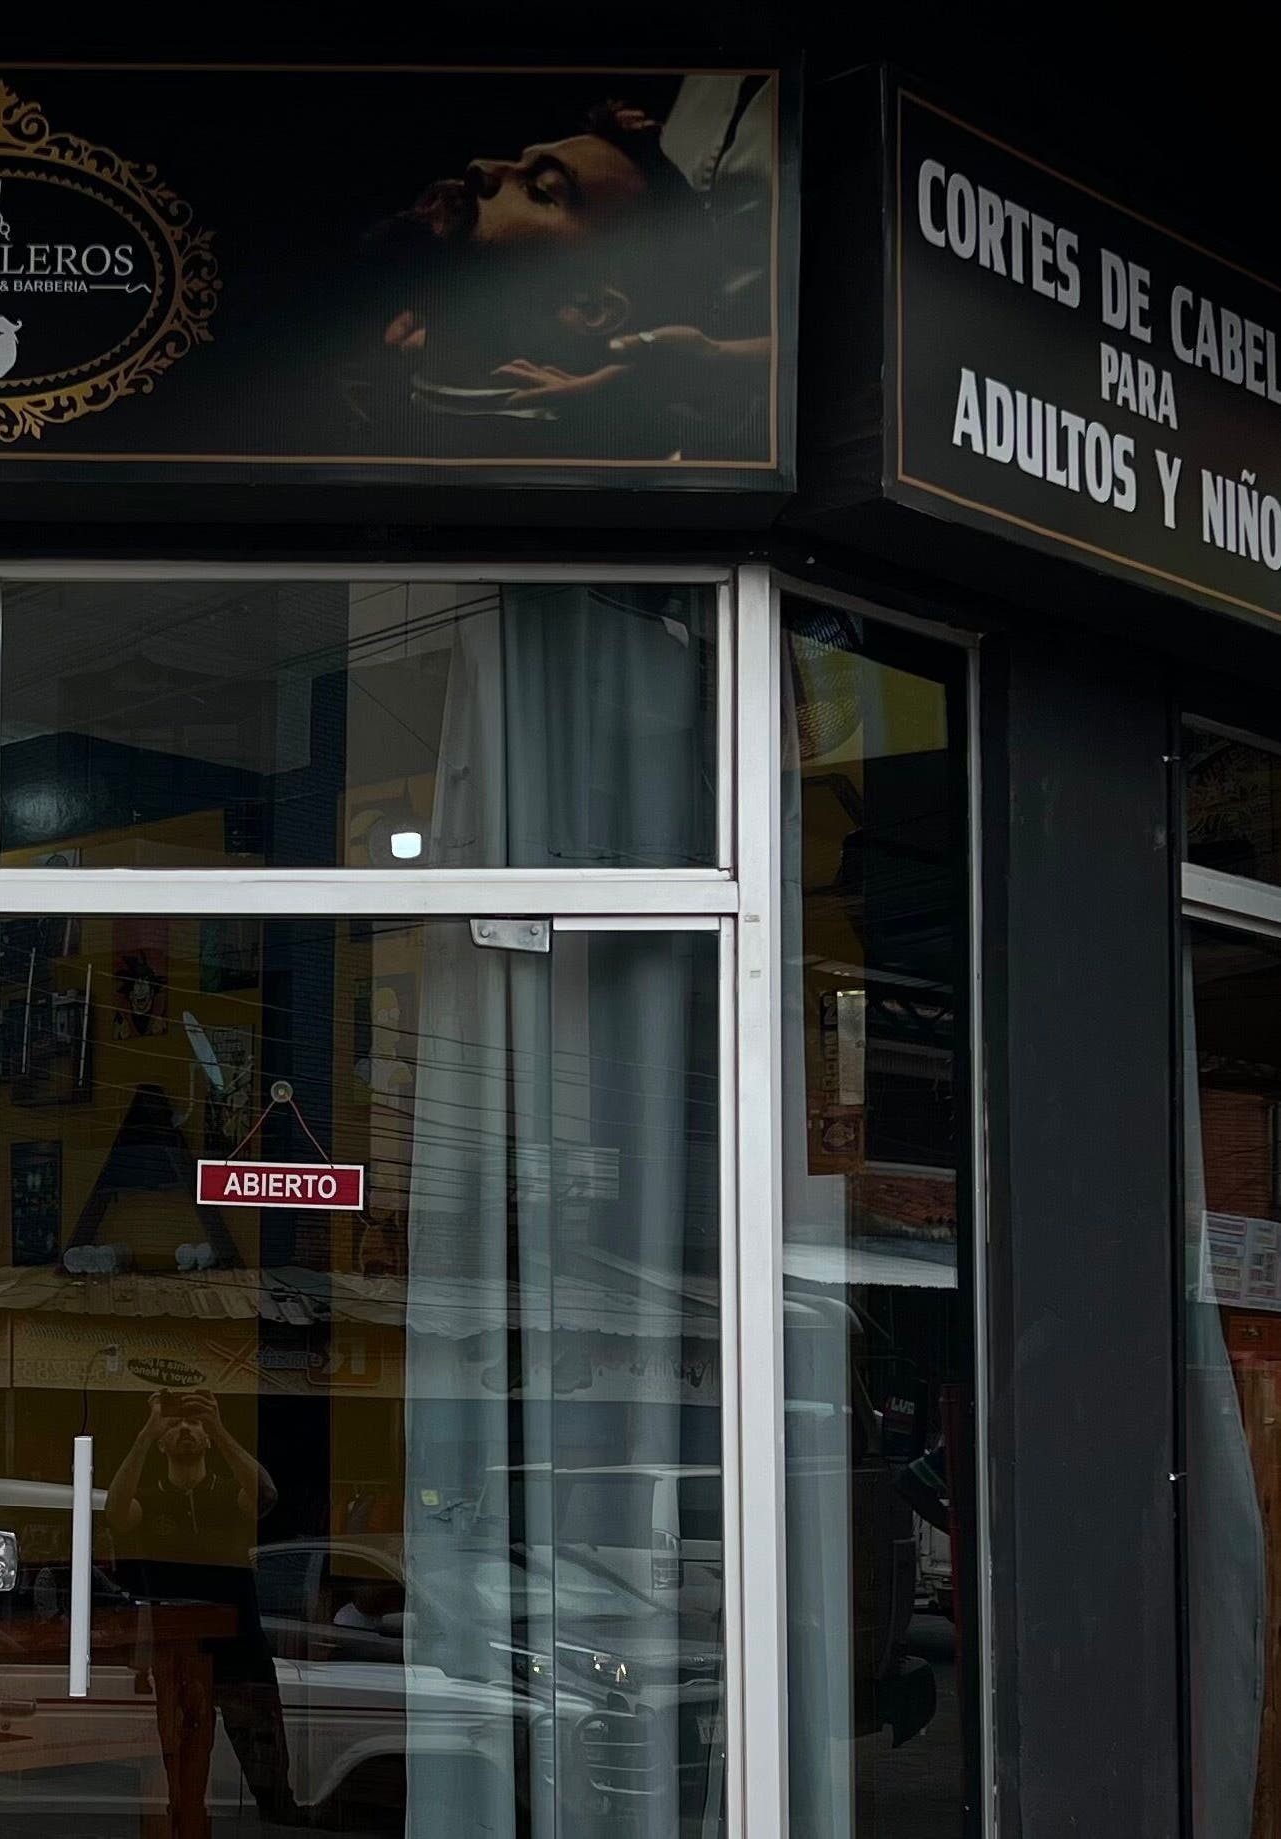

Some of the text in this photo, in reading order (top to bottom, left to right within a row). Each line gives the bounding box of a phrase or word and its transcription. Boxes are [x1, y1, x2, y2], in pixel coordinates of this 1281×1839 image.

[0, 280, 10, 293] &
[13, 280, 88, 293] BARBERIA
[918, 158, 1281, 406] CORTES DE CABEL
[1100, 341, 1178, 430] PARA
[952, 367, 1281, 571] ADULTOS Y NIÑO
[223, 1172, 337, 1199] ABIERTO
